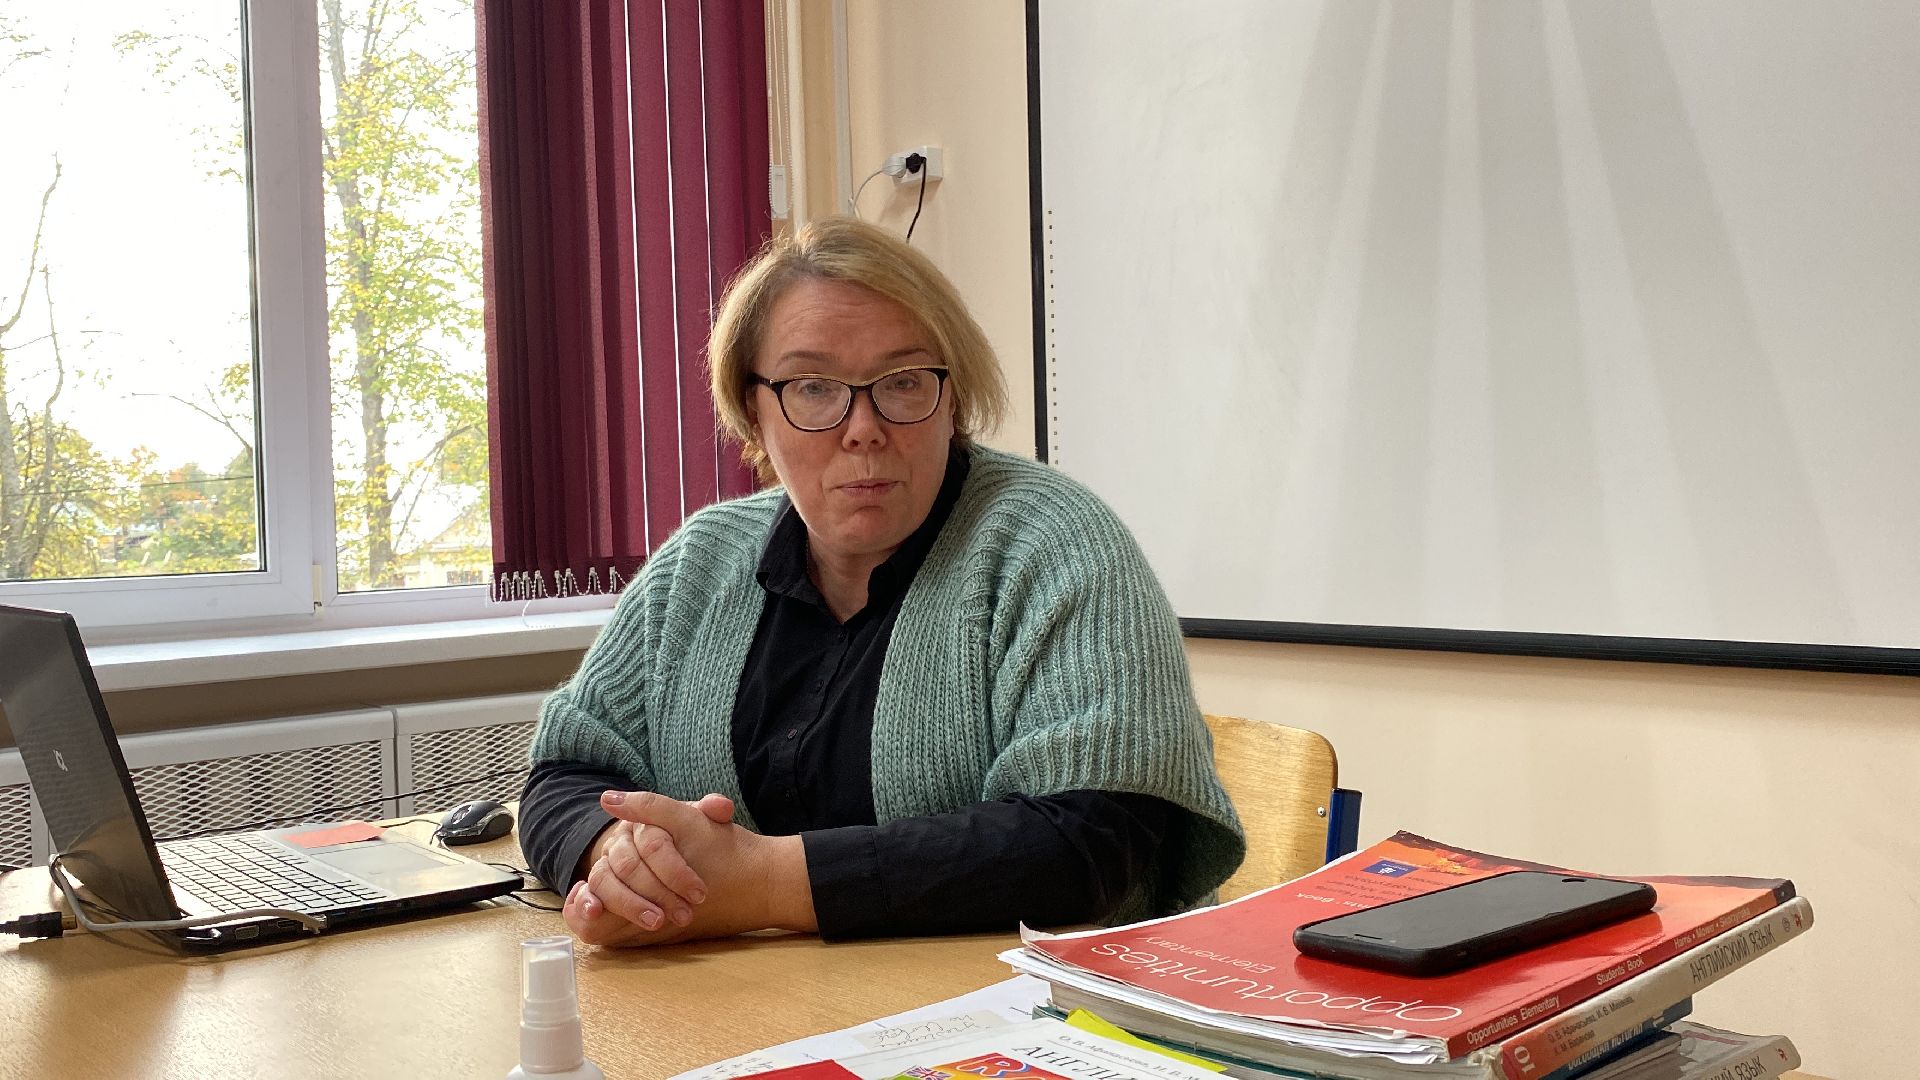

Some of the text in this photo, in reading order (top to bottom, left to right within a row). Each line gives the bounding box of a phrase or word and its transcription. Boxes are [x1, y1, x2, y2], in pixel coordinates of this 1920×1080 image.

[1295, 892, 1335, 903] Book
[1136, 936, 1276, 974] Elementary
[1689, 923, 1776, 985] АНГЛИЙСКИЙ ЯЗЫК
[1091, 943, 1463, 1022] Opportunities
[1466, 1013, 1519, 1046] Opportunities
[1519, 994, 1560, 1022] Elementary
[1626, 956, 1645, 973] Book
[1514, 1046, 1536, 1073] 10
[1734, 1055, 1768, 1080] ЯЗЫК
